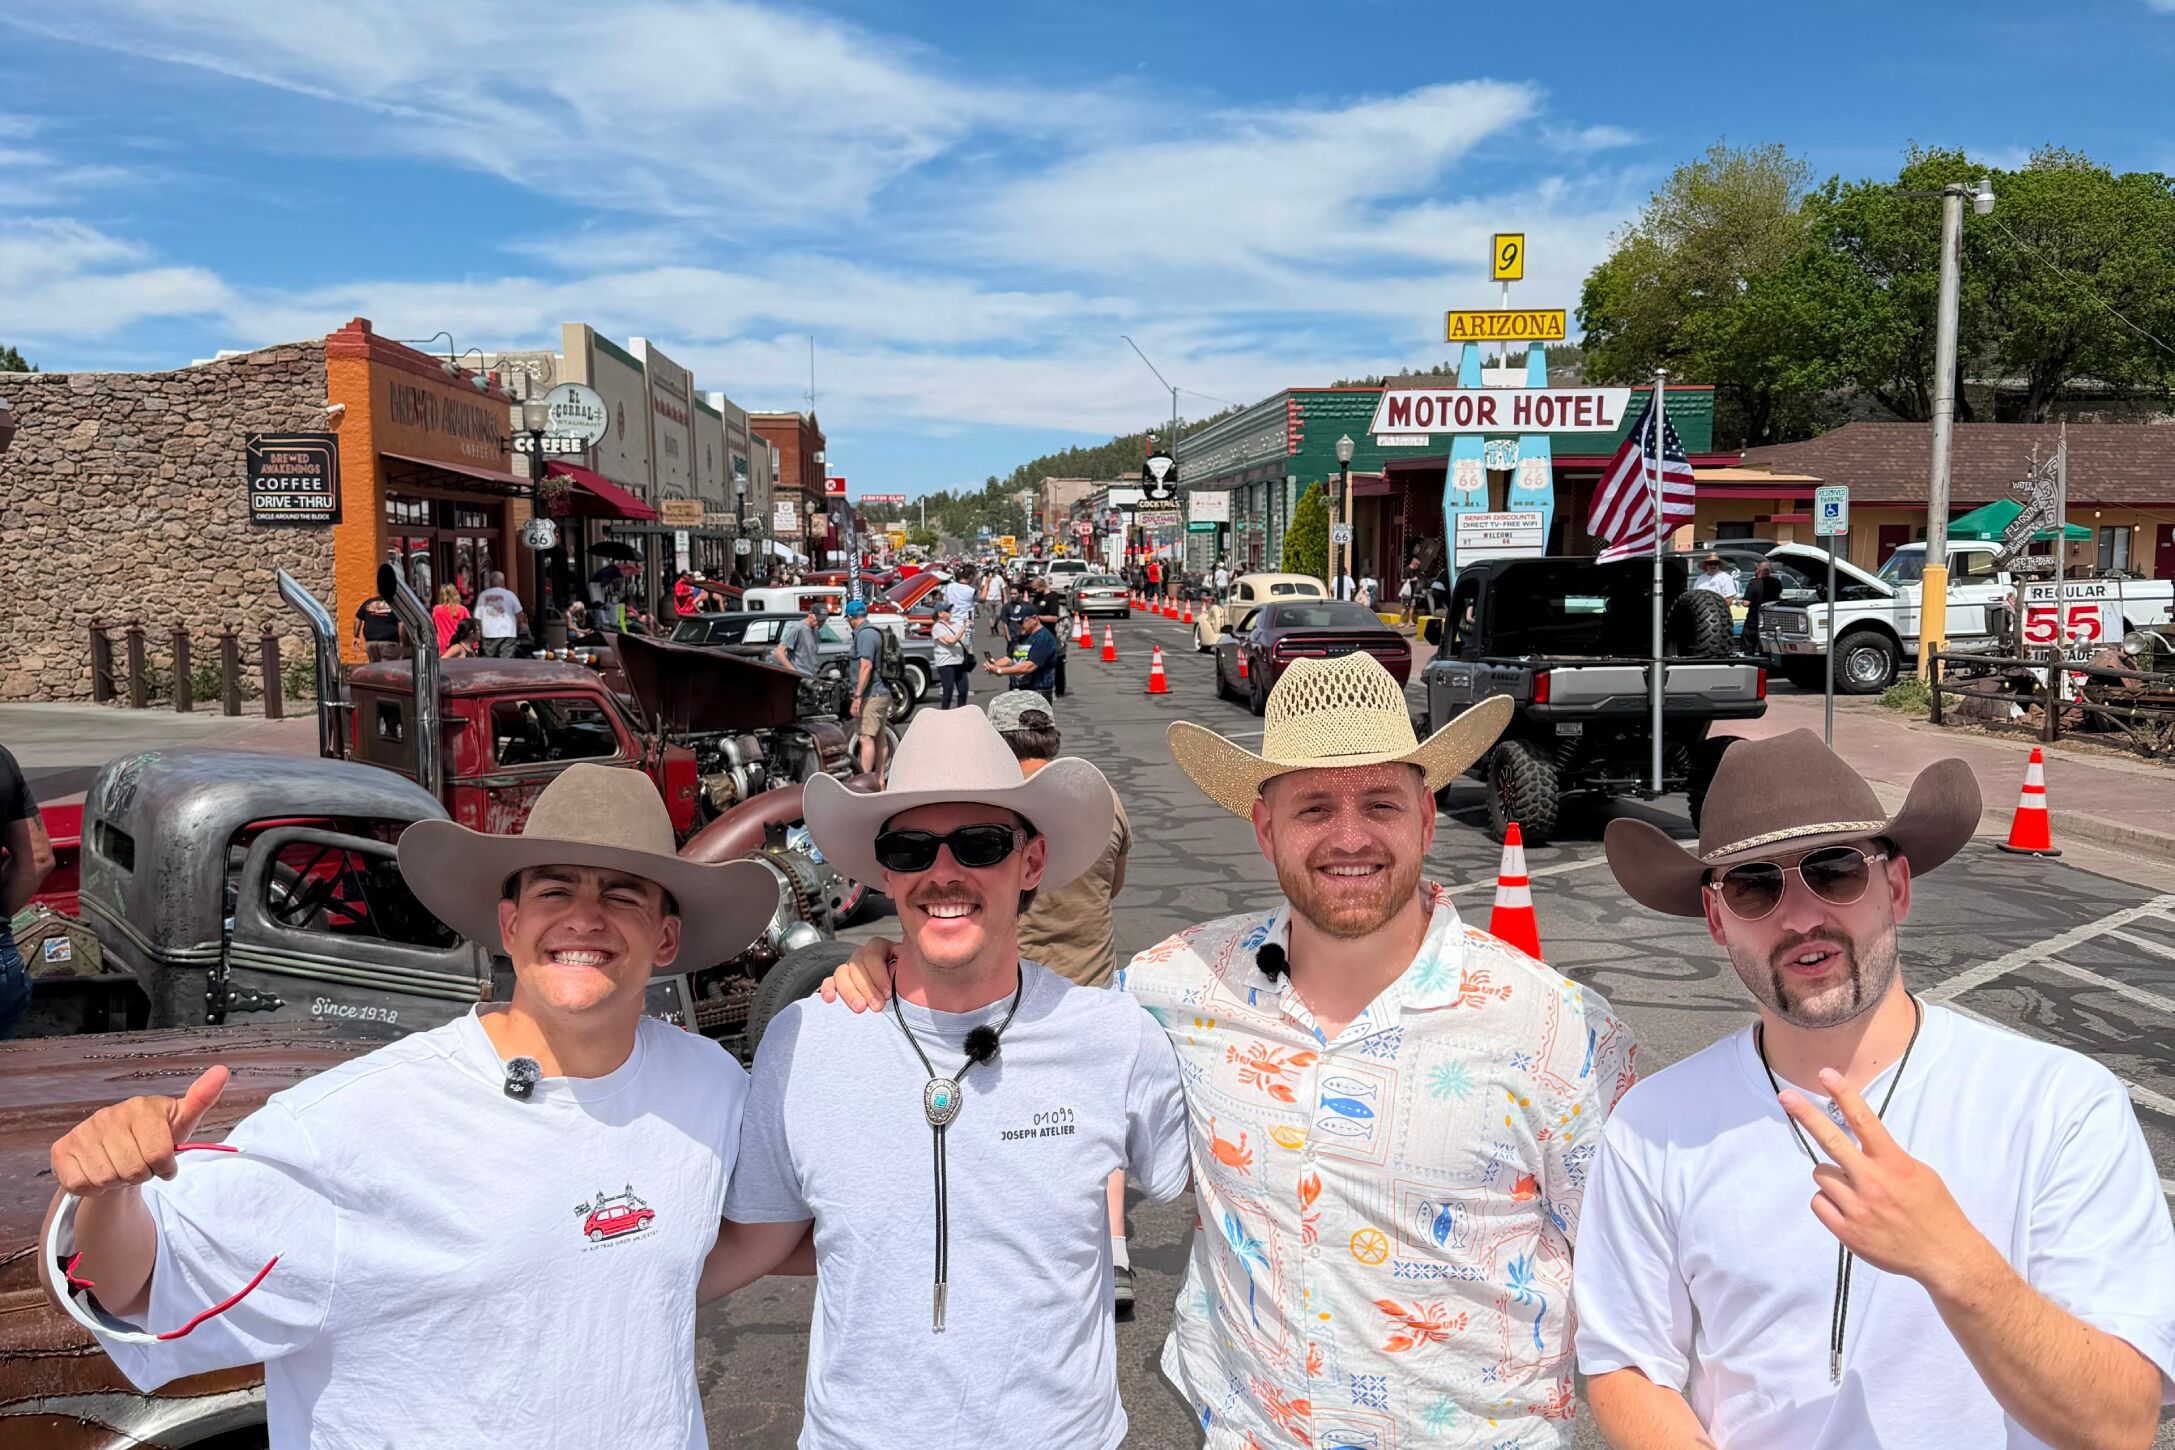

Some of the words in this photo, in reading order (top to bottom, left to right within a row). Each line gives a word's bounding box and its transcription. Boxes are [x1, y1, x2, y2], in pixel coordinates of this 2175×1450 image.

[1499, 242, 1518, 271] 9
[1451, 314, 1562, 337] ARIZONA
[556, 403, 593, 420] CORRAL
[1387, 395, 1499, 428] MOTOR
[1513, 395, 1614, 427] HOTEL
[270, 454, 309, 463] BREWED
[1487, 444, 1517, 465] TV
[261, 464, 321, 474] AWAKENINGS
[255, 478, 321, 490] COFFEE
[1459, 474, 1478, 487] 66
[1524, 473, 1543, 486] 66
[1139, 500, 1180, 508] COCKTAILS
[529, 533, 548, 545] 66
[1335, 532, 1348, 541] 66
[2024, 606, 2101, 643] 55
[312, 997, 358, 1018] Since
[360, 1006, 398, 1024] 1938
[1033, 1107, 1075, 1126] 01099
[1001, 1128, 1037, 1140] JOSEPH
[1040, 1125, 1075, 1137] ATELIER
